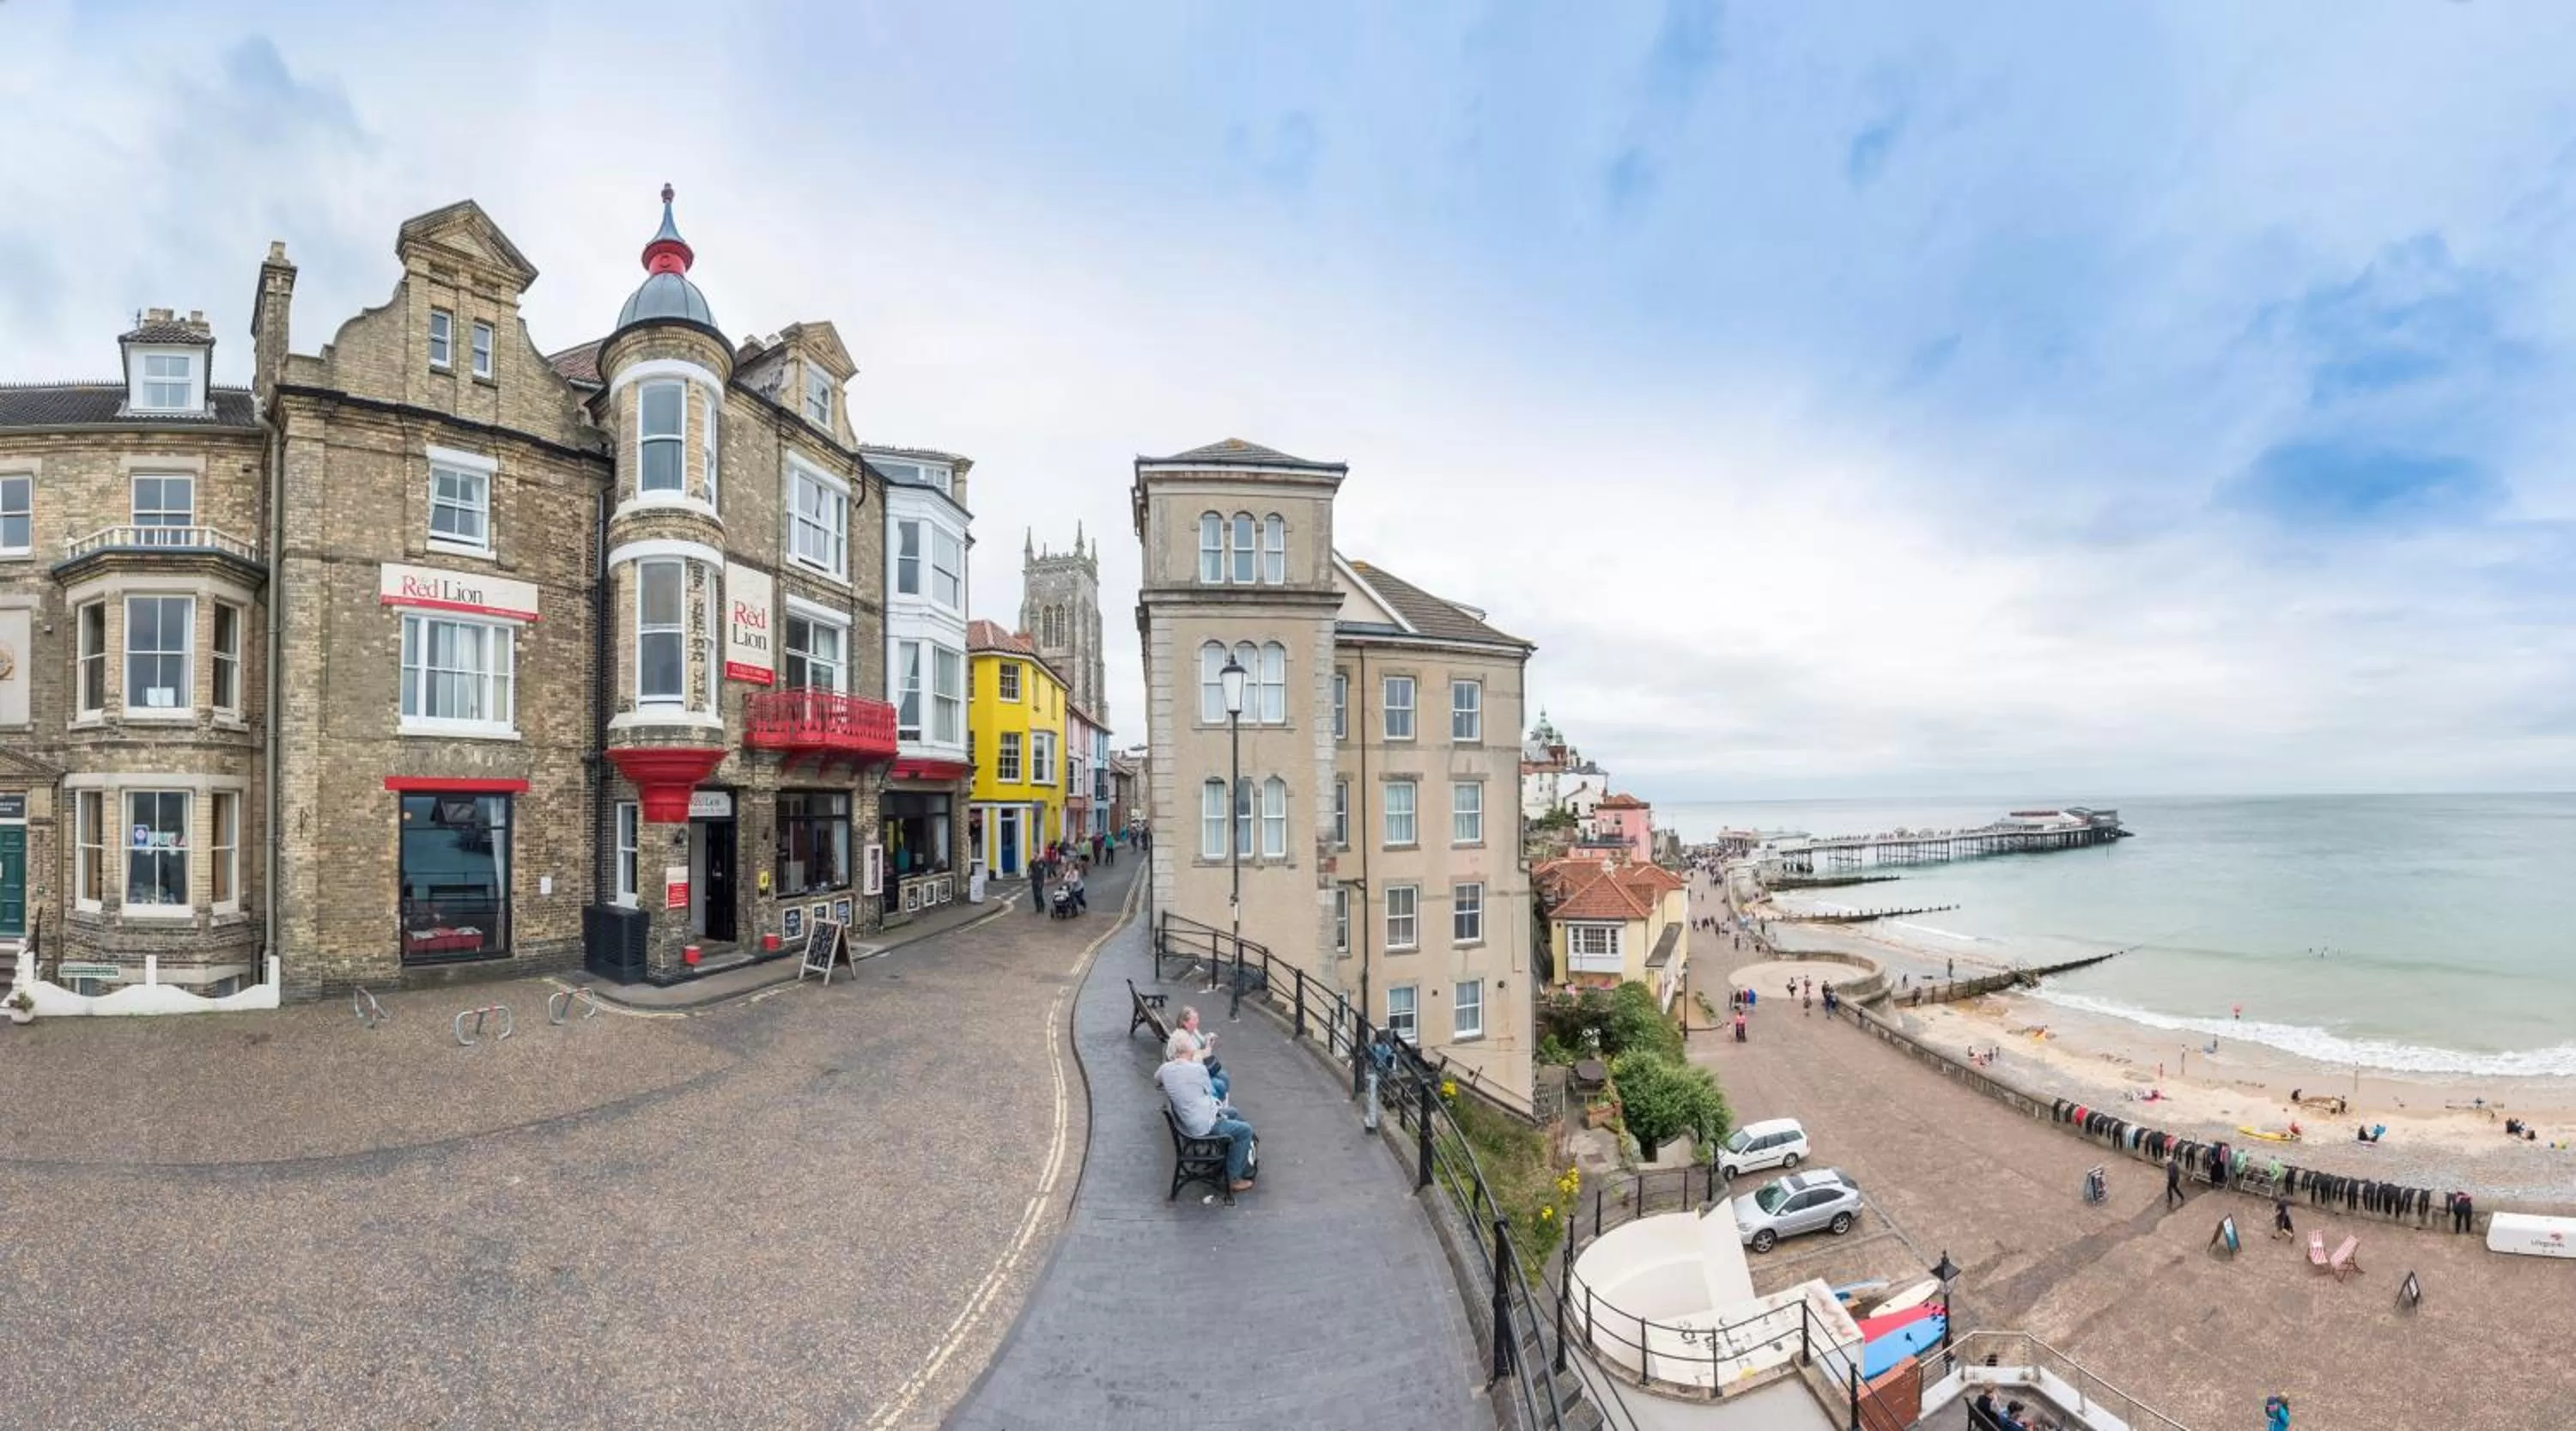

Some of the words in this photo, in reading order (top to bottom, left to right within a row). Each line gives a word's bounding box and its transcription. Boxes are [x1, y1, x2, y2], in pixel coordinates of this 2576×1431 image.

[402, 575, 439, 599] Red
[442, 580, 483, 604] Lion
[734, 600, 766, 629] Red
[732, 623, 767, 650] Lion
